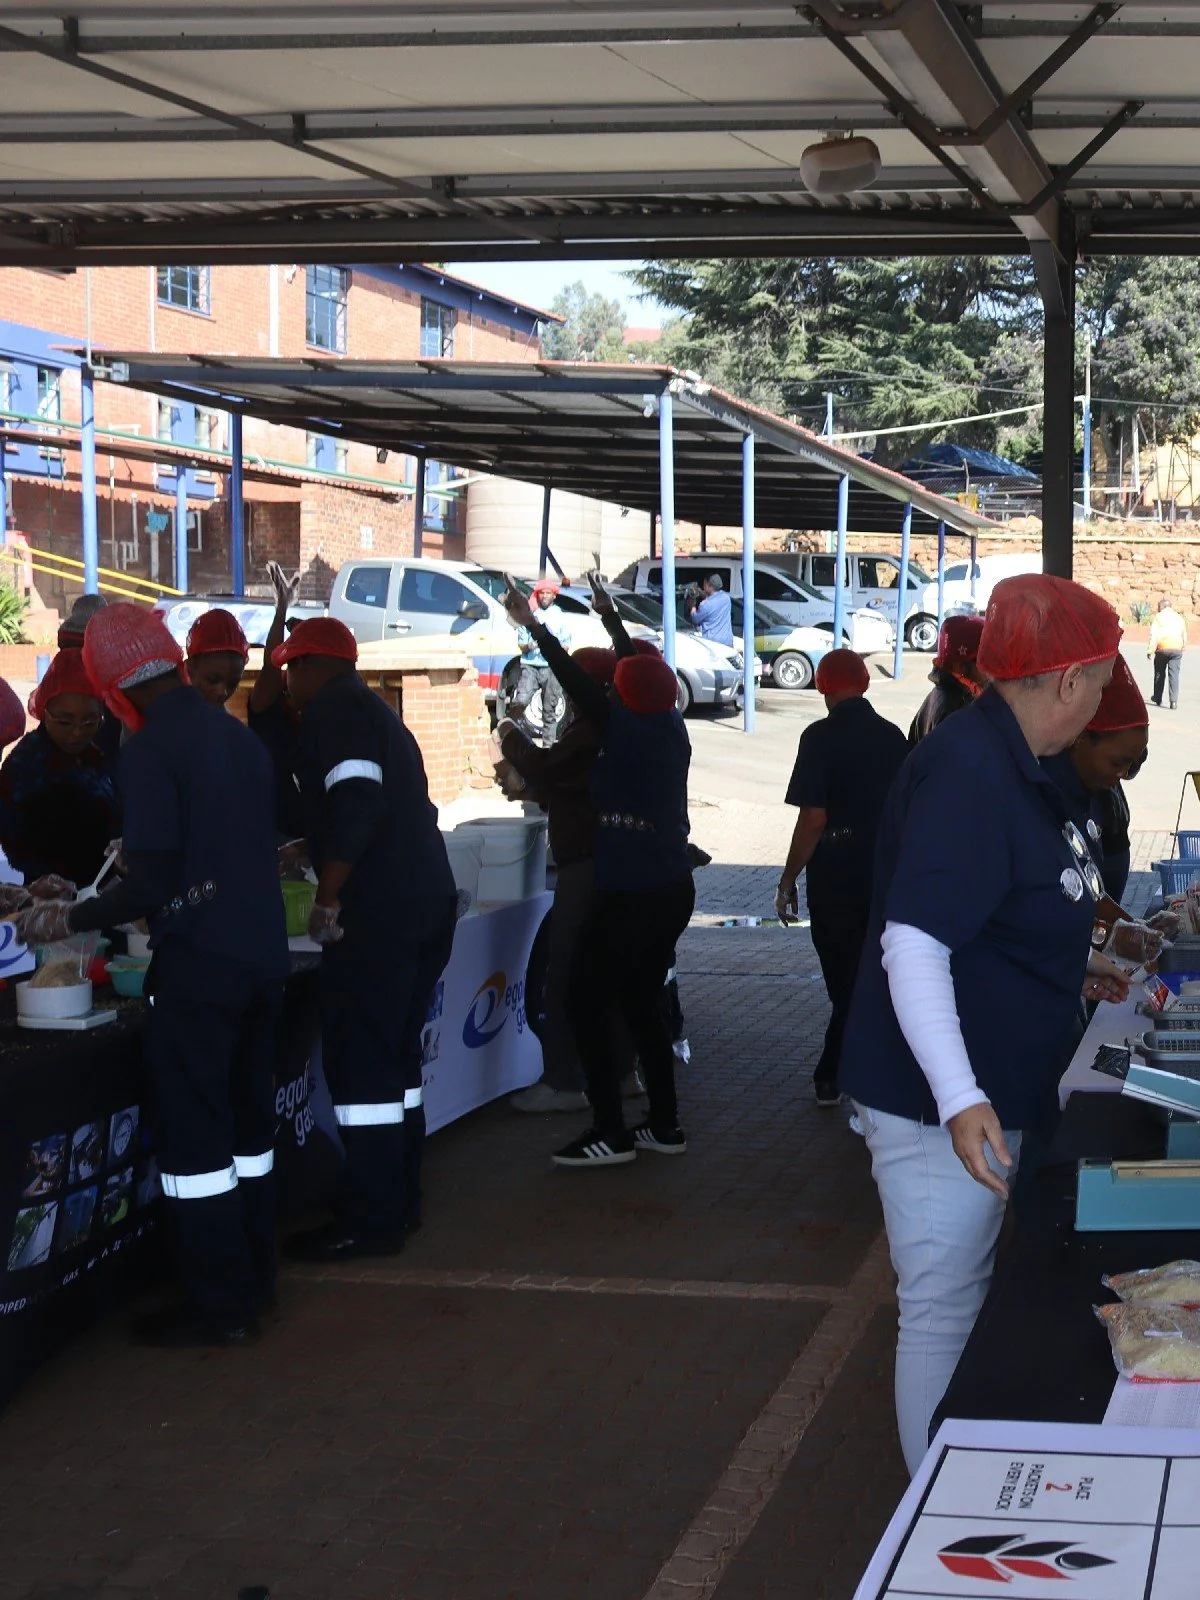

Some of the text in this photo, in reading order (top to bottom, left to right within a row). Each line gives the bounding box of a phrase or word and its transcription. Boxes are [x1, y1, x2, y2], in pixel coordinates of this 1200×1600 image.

[995, 1462, 1025, 1511] EVERY BLOCK
[1022, 1463, 1045, 1496] PACKETS
[1045, 1483, 1073, 1491] 2
[1075, 1477, 1094, 1500] PLACE
